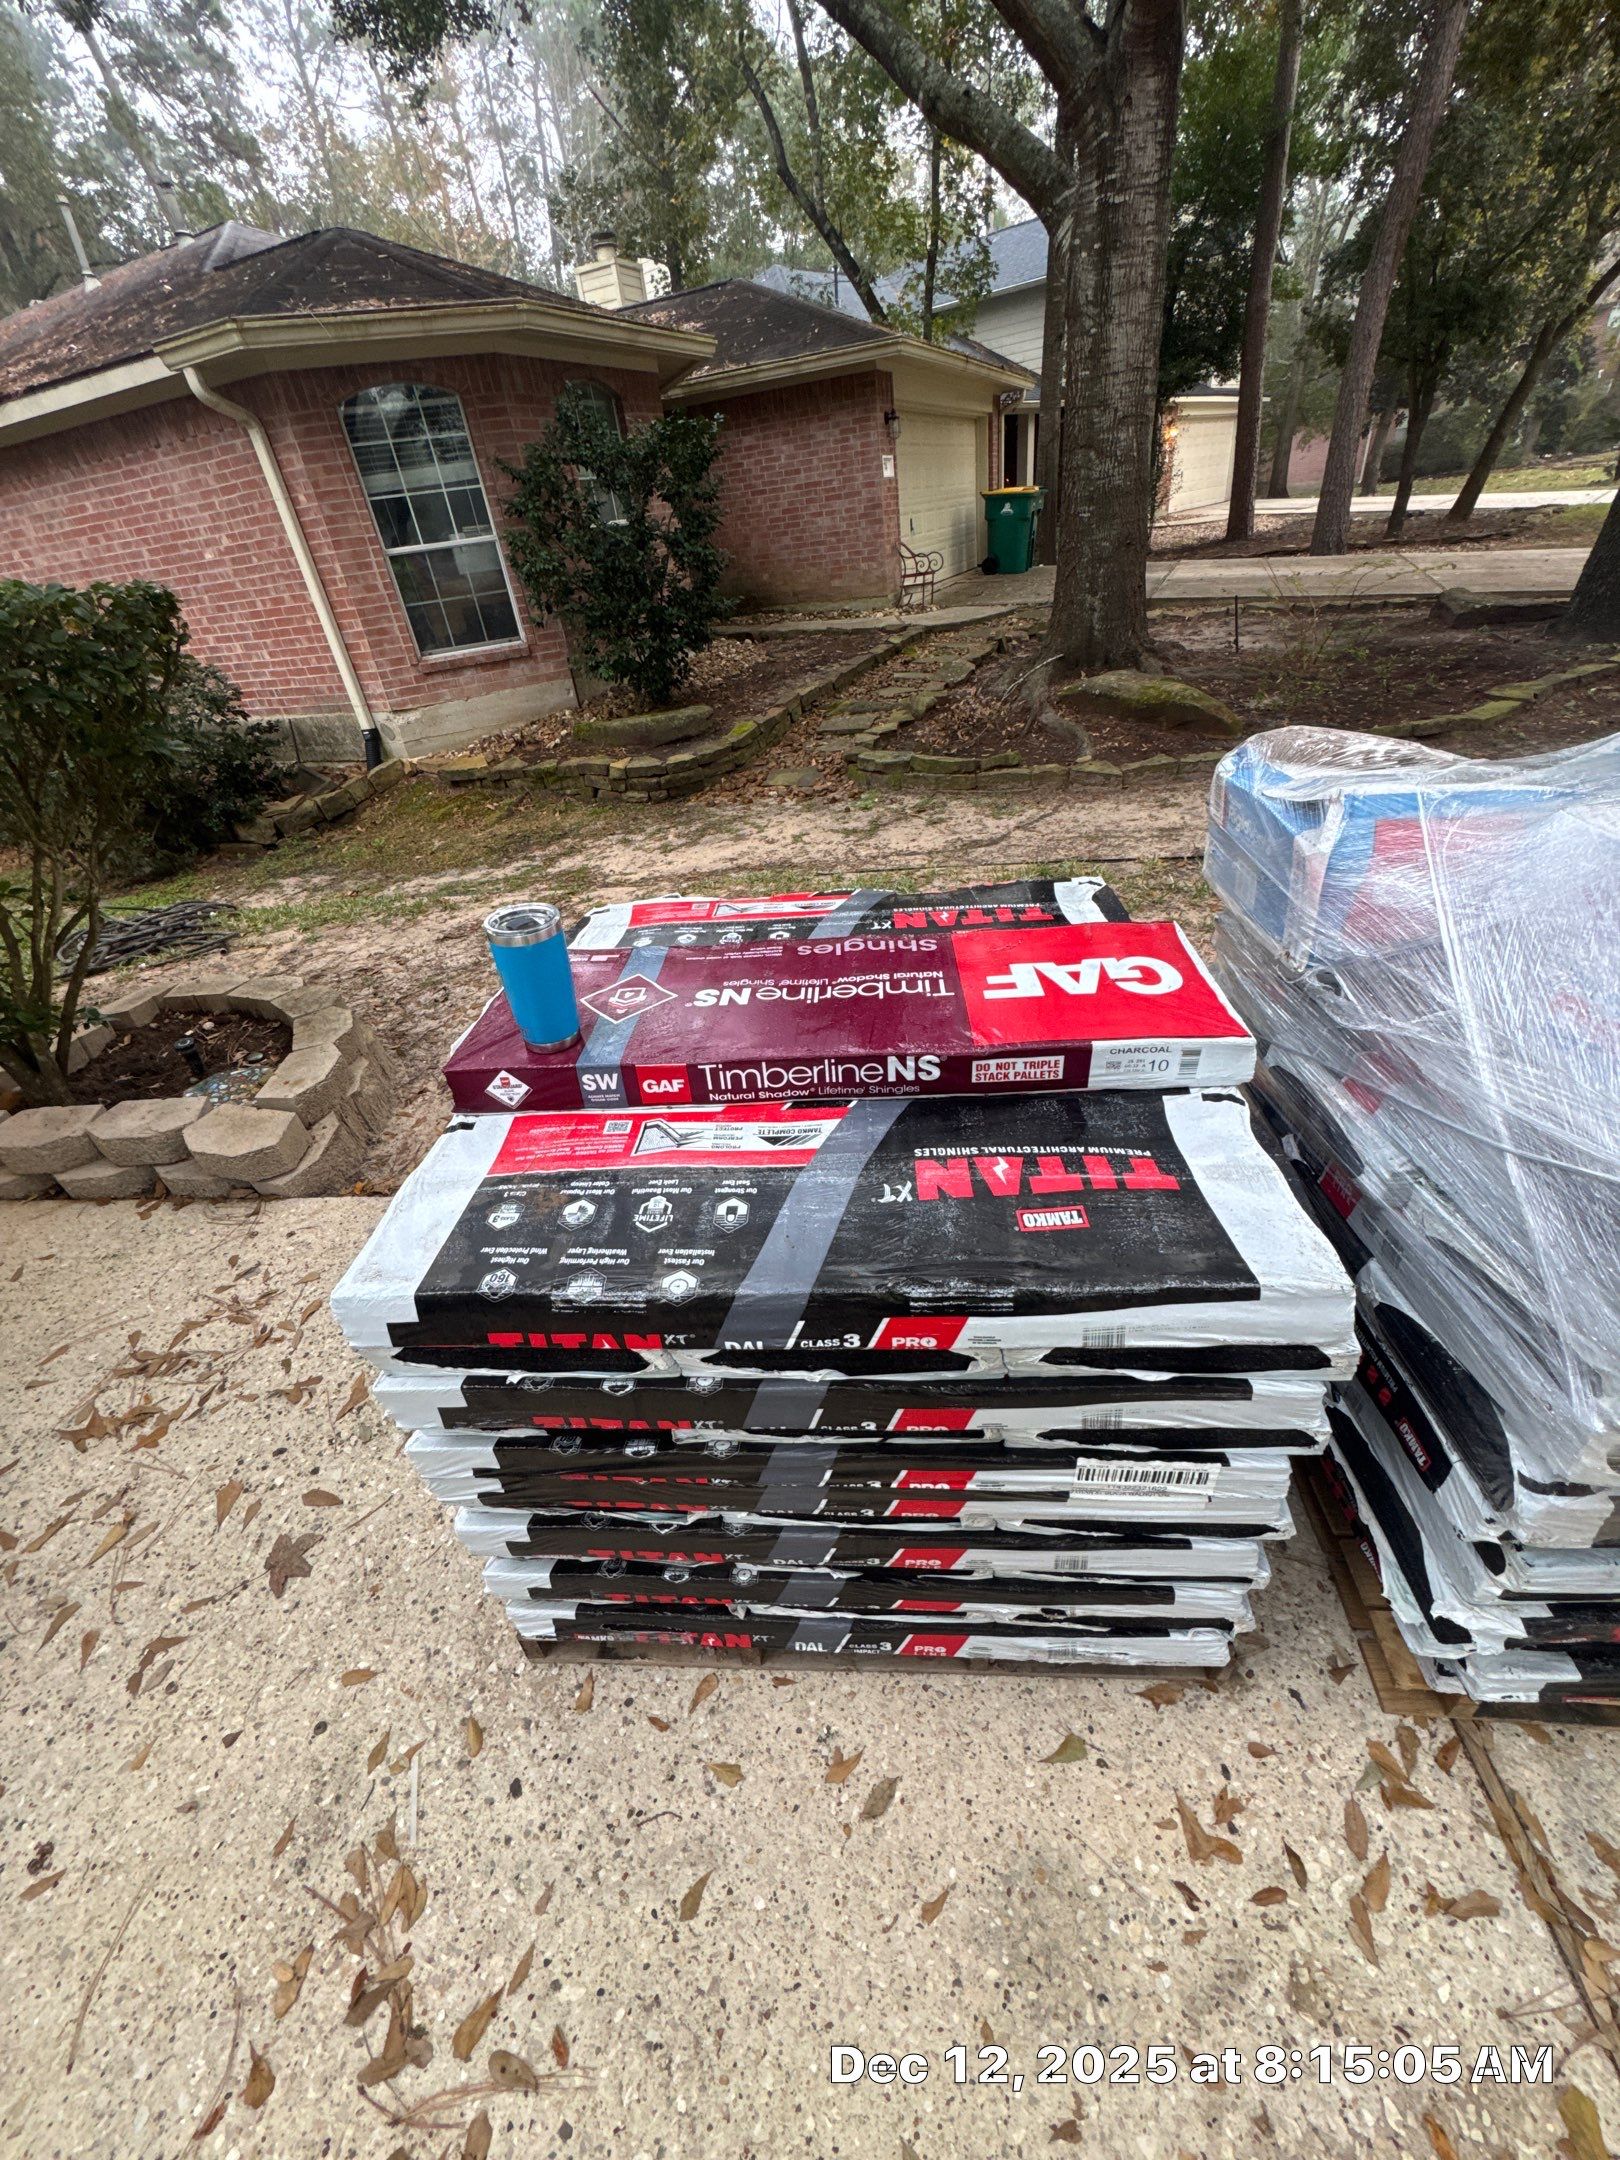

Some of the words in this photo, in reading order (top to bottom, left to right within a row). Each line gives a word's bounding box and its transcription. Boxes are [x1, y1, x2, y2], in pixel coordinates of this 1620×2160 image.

[893, 908, 1054, 928] TITAN
[871, 920, 892, 930] XT
[797, 938, 938, 957] Shingles
[894, 970, 944, 980] Natural
[983, 956, 1184, 1000] GAF
[723, 978, 776, 988] Shingles
[1110, 1046, 1172, 1056] CHARCOAL
[976, 1063, 991, 1072] DO
[996, 1062, 1018, 1071] NOT
[1022, 1060, 1060, 1070] TRIPLE
[1149, 1060, 1170, 1072] 10
[976, 1072, 1010, 1081] STACK
[1013, 1070, 1060, 1080] PALLETS
[581, 1073, 618, 1091] SW
[642, 1079, 686, 1094] GAF
[709, 1091, 756, 1101] Natural
[869, 1084, 920, 1095] Shingles
[757, 1128, 796, 1136] COMPLETE
[914, 1147, 979, 1157] SHINGLES
[980, 1146, 1085, 1154] ARCHITECTURAL
[1088, 1146, 1152, 1158] PREMIUM
[915, 1156, 1180, 1200] TITAN
[587, 1188, 603, 1196] Most
[604, 1188, 616, 1196] Our
[664, 1187, 680, 1195] Most
[680, 1187, 692, 1195] Our
[746, 1186, 758, 1194] Our
[878, 1181, 913, 1202] XT
[632, 1214, 674, 1222] LIFETIME
[1022, 1210, 1083, 1227] TAMKO
[480, 1246, 495, 1254] Ever
[531, 1247, 548, 1255] Wind
[567, 1247, 588, 1256] Layer
[589, 1247, 628, 1256] Weathering
[658, 1248, 672, 1256] Ever
[674, 1248, 715, 1256] Installation
[490, 1256, 516, 1264] Highest
[559, 1256, 599, 1266] Performing
[600, 1256, 616, 1266] High
[618, 1257, 630, 1266] Our
[664, 1258, 692, 1266] Fastest
[692, 1258, 705, 1266] Our
[490, 1274, 510, 1283] 160
[487, 1332, 662, 1349] TITAN
[664, 1334, 688, 1346] XT
[800, 1338, 840, 1348] CLASS
[843, 1333, 860, 1348] 3
[892, 1336, 938, 1348] PRO
[1400, 1422, 1426, 1466] TAMKO
[587, 1550, 726, 1563] TITAN
[752, 1634, 768, 1642] XT
[795, 1642, 828, 1652] DAL
[880, 1641, 892, 1650] 3
